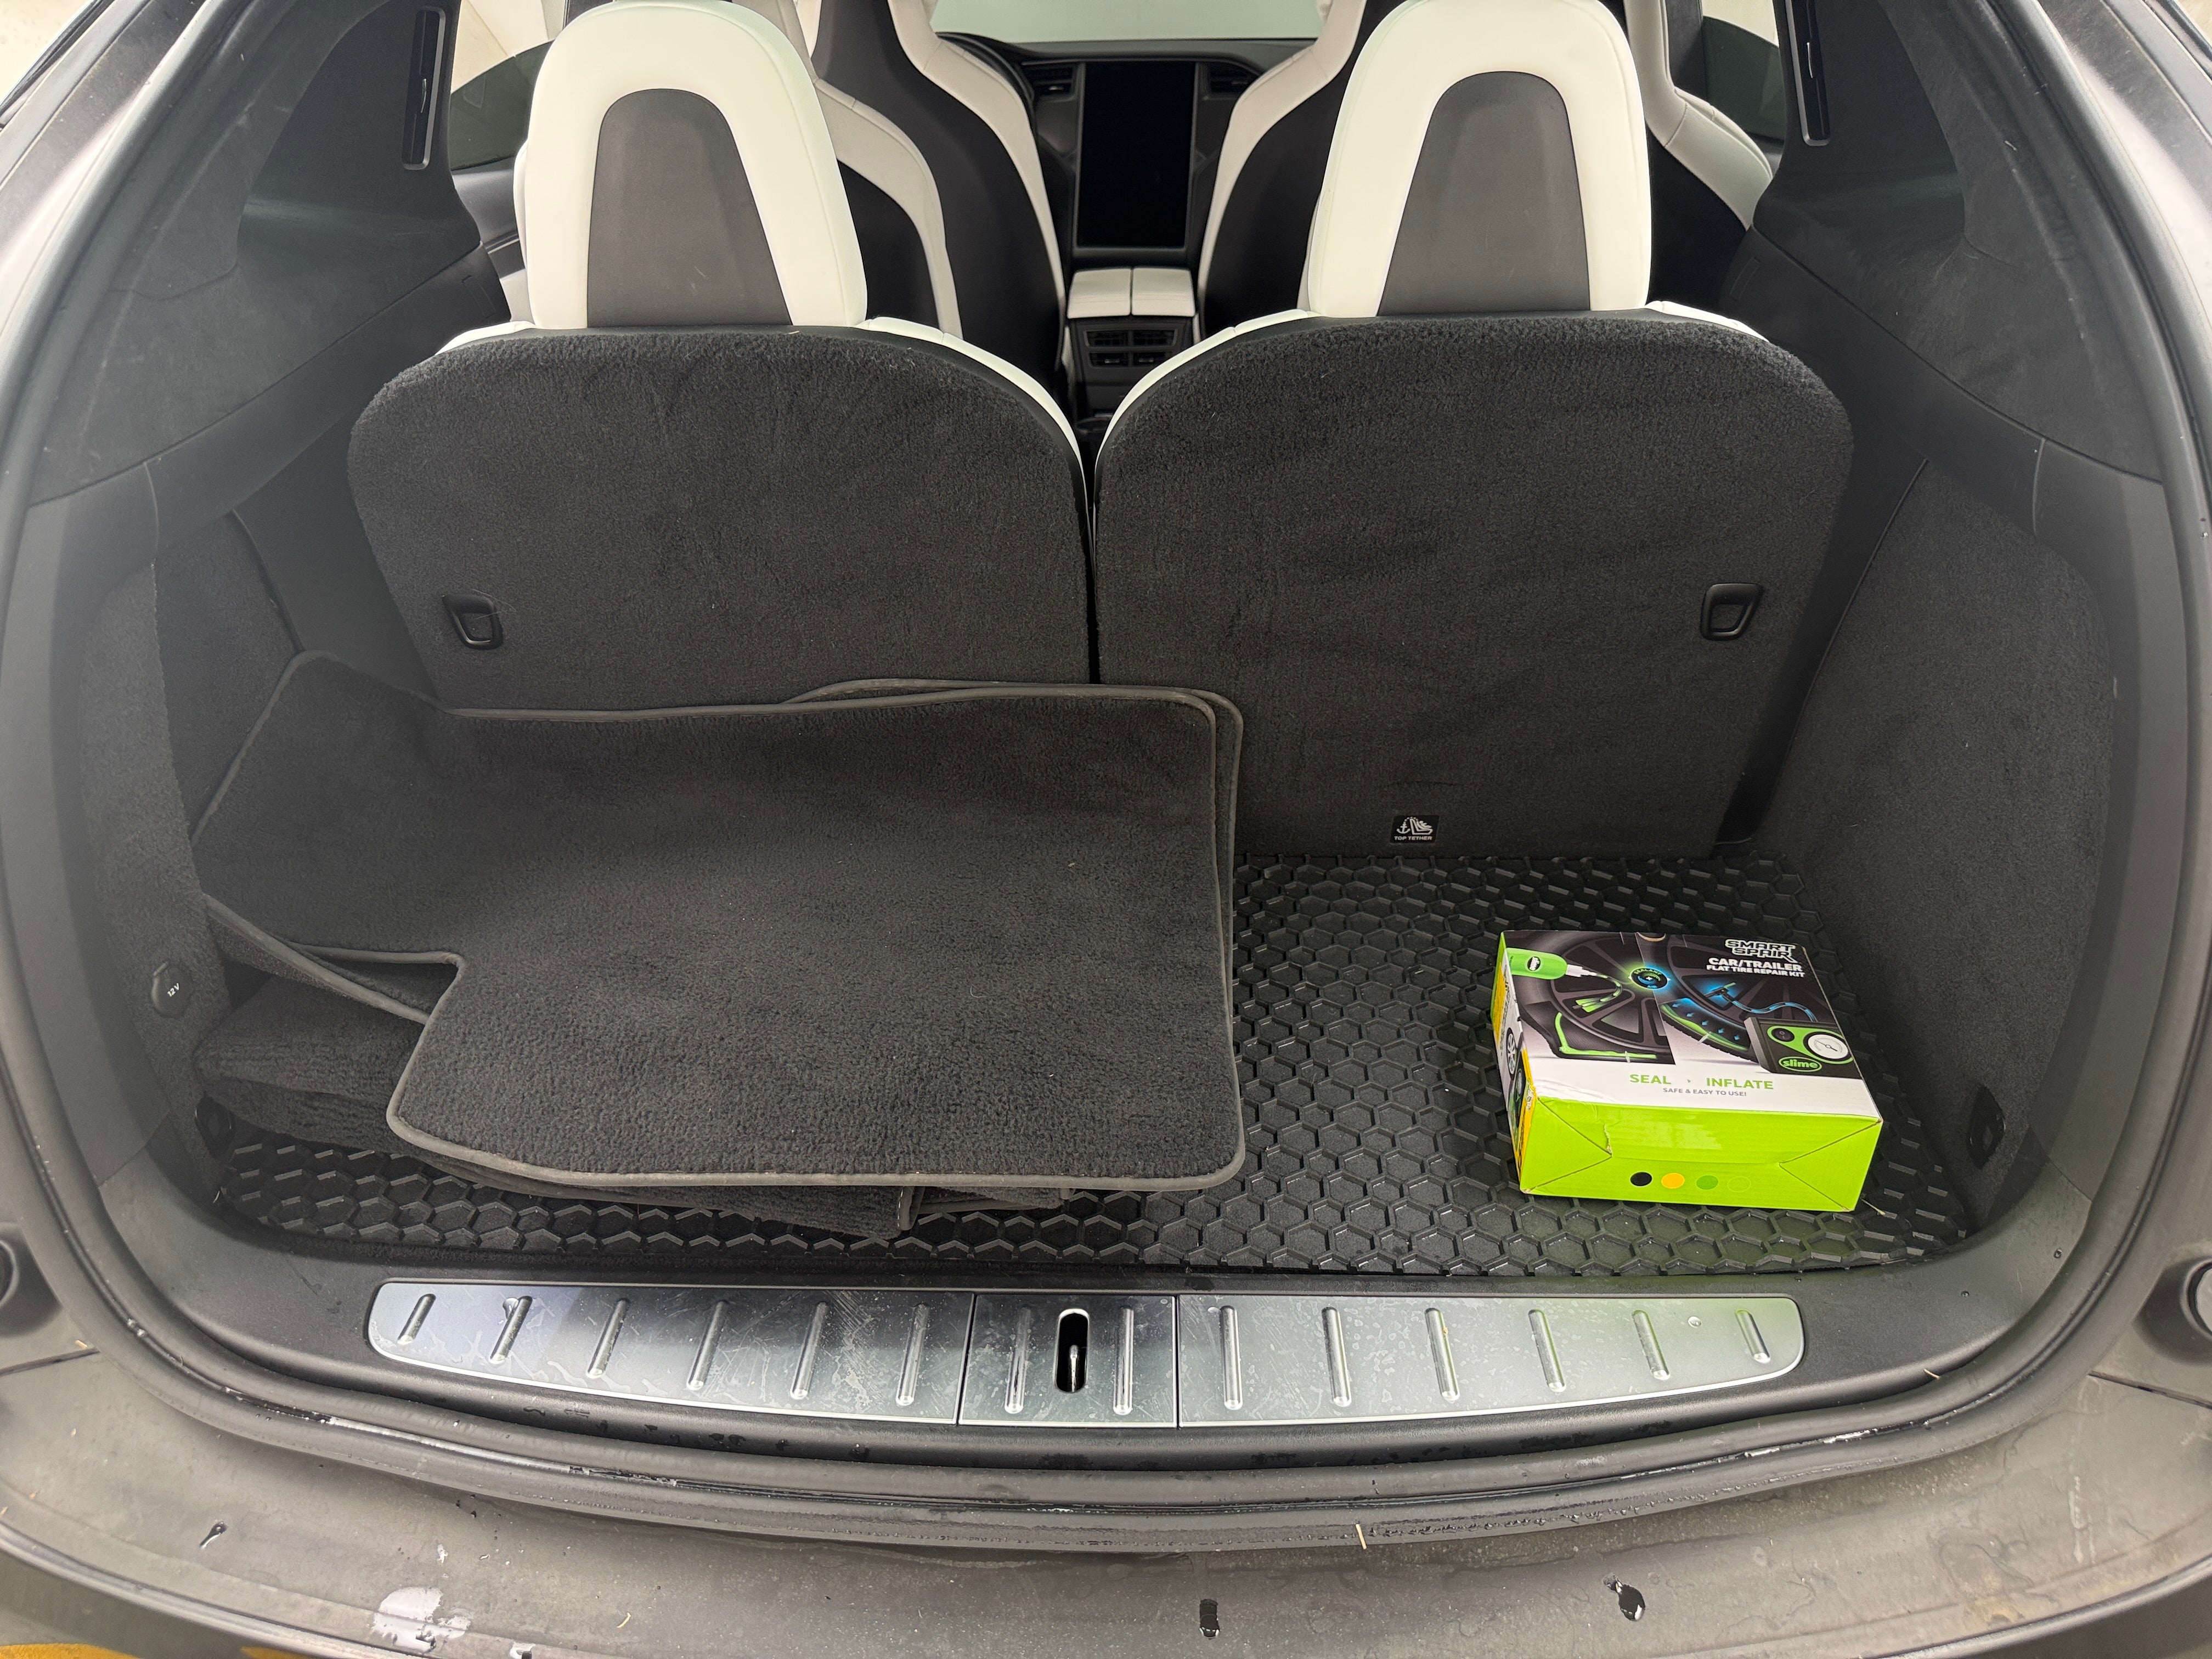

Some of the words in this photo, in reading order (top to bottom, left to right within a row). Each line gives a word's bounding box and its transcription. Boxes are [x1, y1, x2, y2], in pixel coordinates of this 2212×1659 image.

[1725, 939, 1796, 952] SMART
[1732, 947, 1798, 963] SPAIR
[1708, 957, 1803, 972] CAR/TRAILER
[1754, 968, 1788, 977] REPAIR
[1783, 1059, 1818, 1069] slime
[1629, 1074, 1672, 1085] SEAL
[1706, 1077, 1774, 1090] INFLATE
